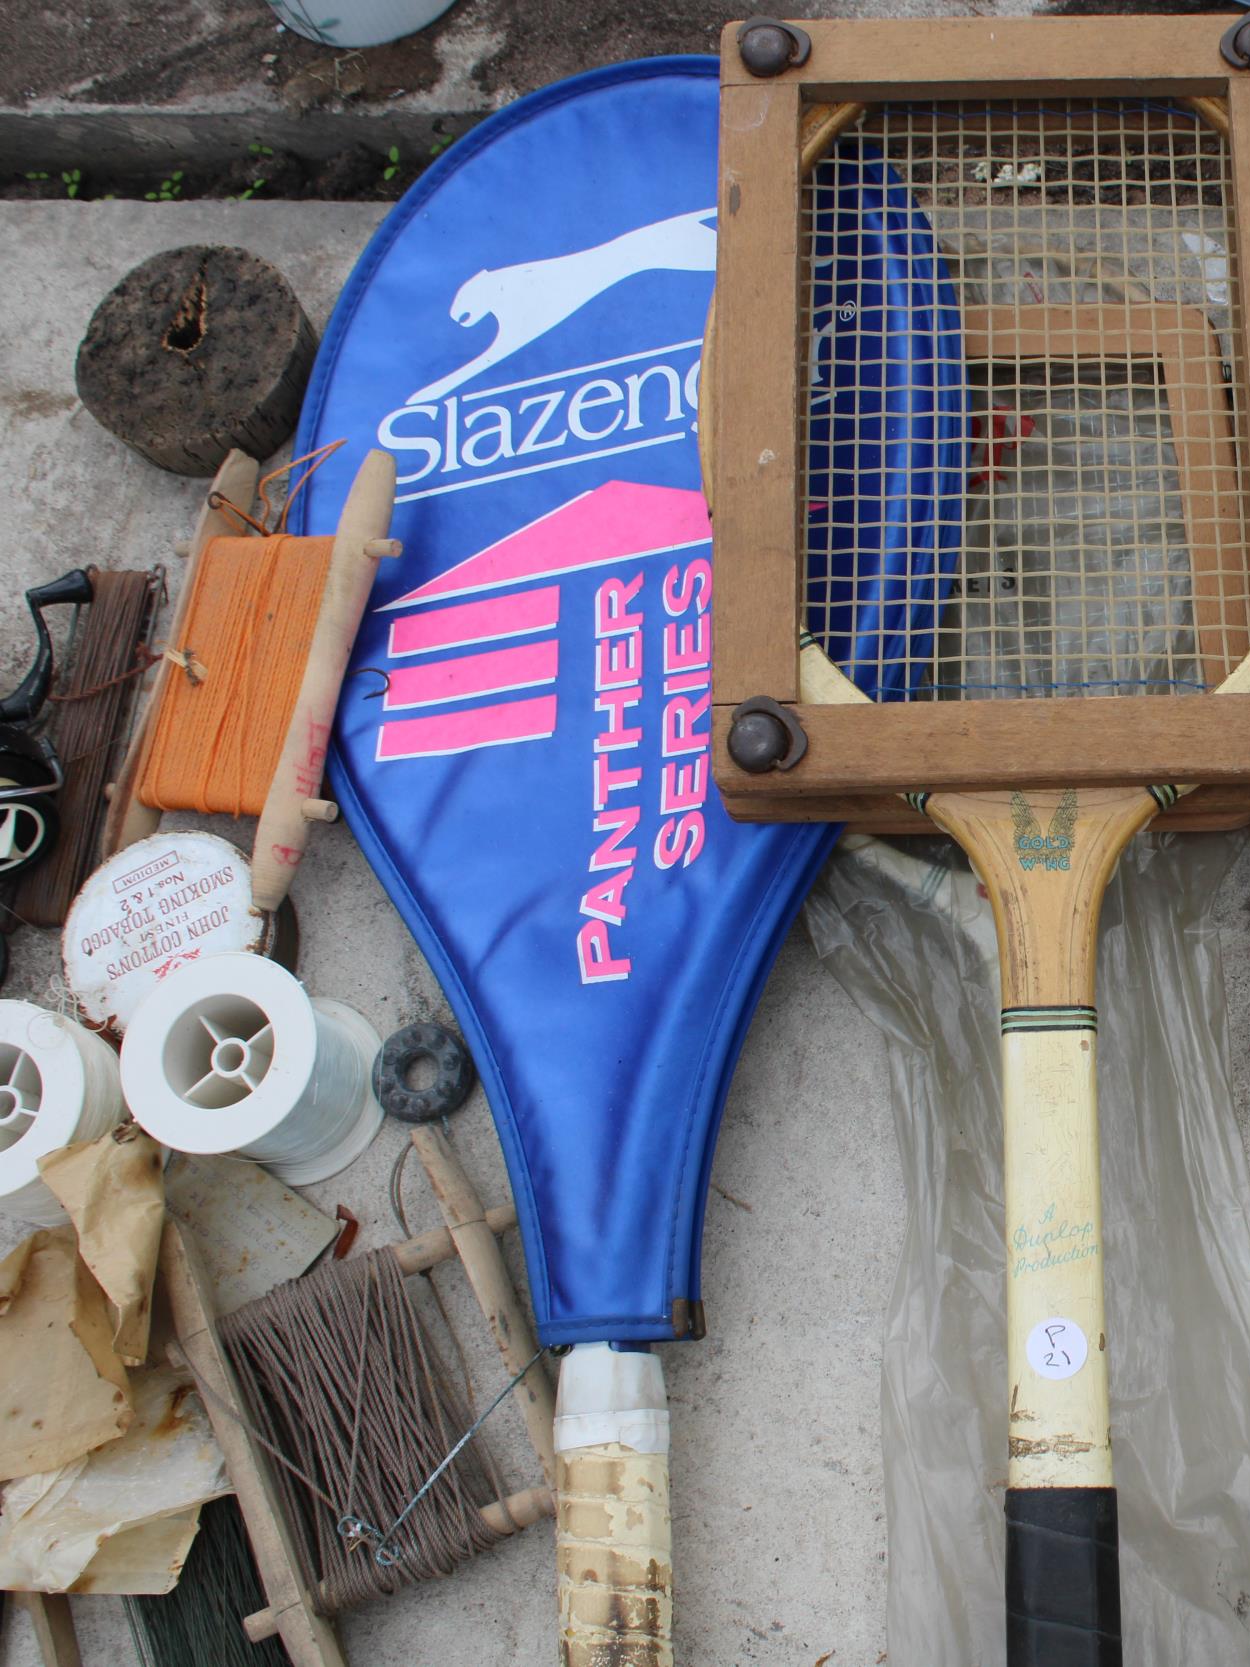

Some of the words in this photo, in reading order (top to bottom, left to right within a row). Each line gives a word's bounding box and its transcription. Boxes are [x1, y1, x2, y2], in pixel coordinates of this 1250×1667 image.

[653, 558, 713, 871] SERIES
[576, 570, 645, 985] PANTHER
[1017, 834, 1072, 850] GOLD
[121, 858, 170, 887] MEDIUM
[1019, 855, 1071, 872] WNG
[119, 899, 131, 912] 2
[132, 891, 144, 905] &
[147, 887, 154, 898] 1
[158, 866, 235, 916] SMOKING
[80, 906, 156, 957] TOBACCO
[140, 911, 190, 943] FINEST
[187, 905, 231, 941] JOHN
[106, 930, 183, 981] COTTON'S
[1013, 1220, 1094, 1250] Dunlop
[1013, 1243, 1099, 1279] Production
